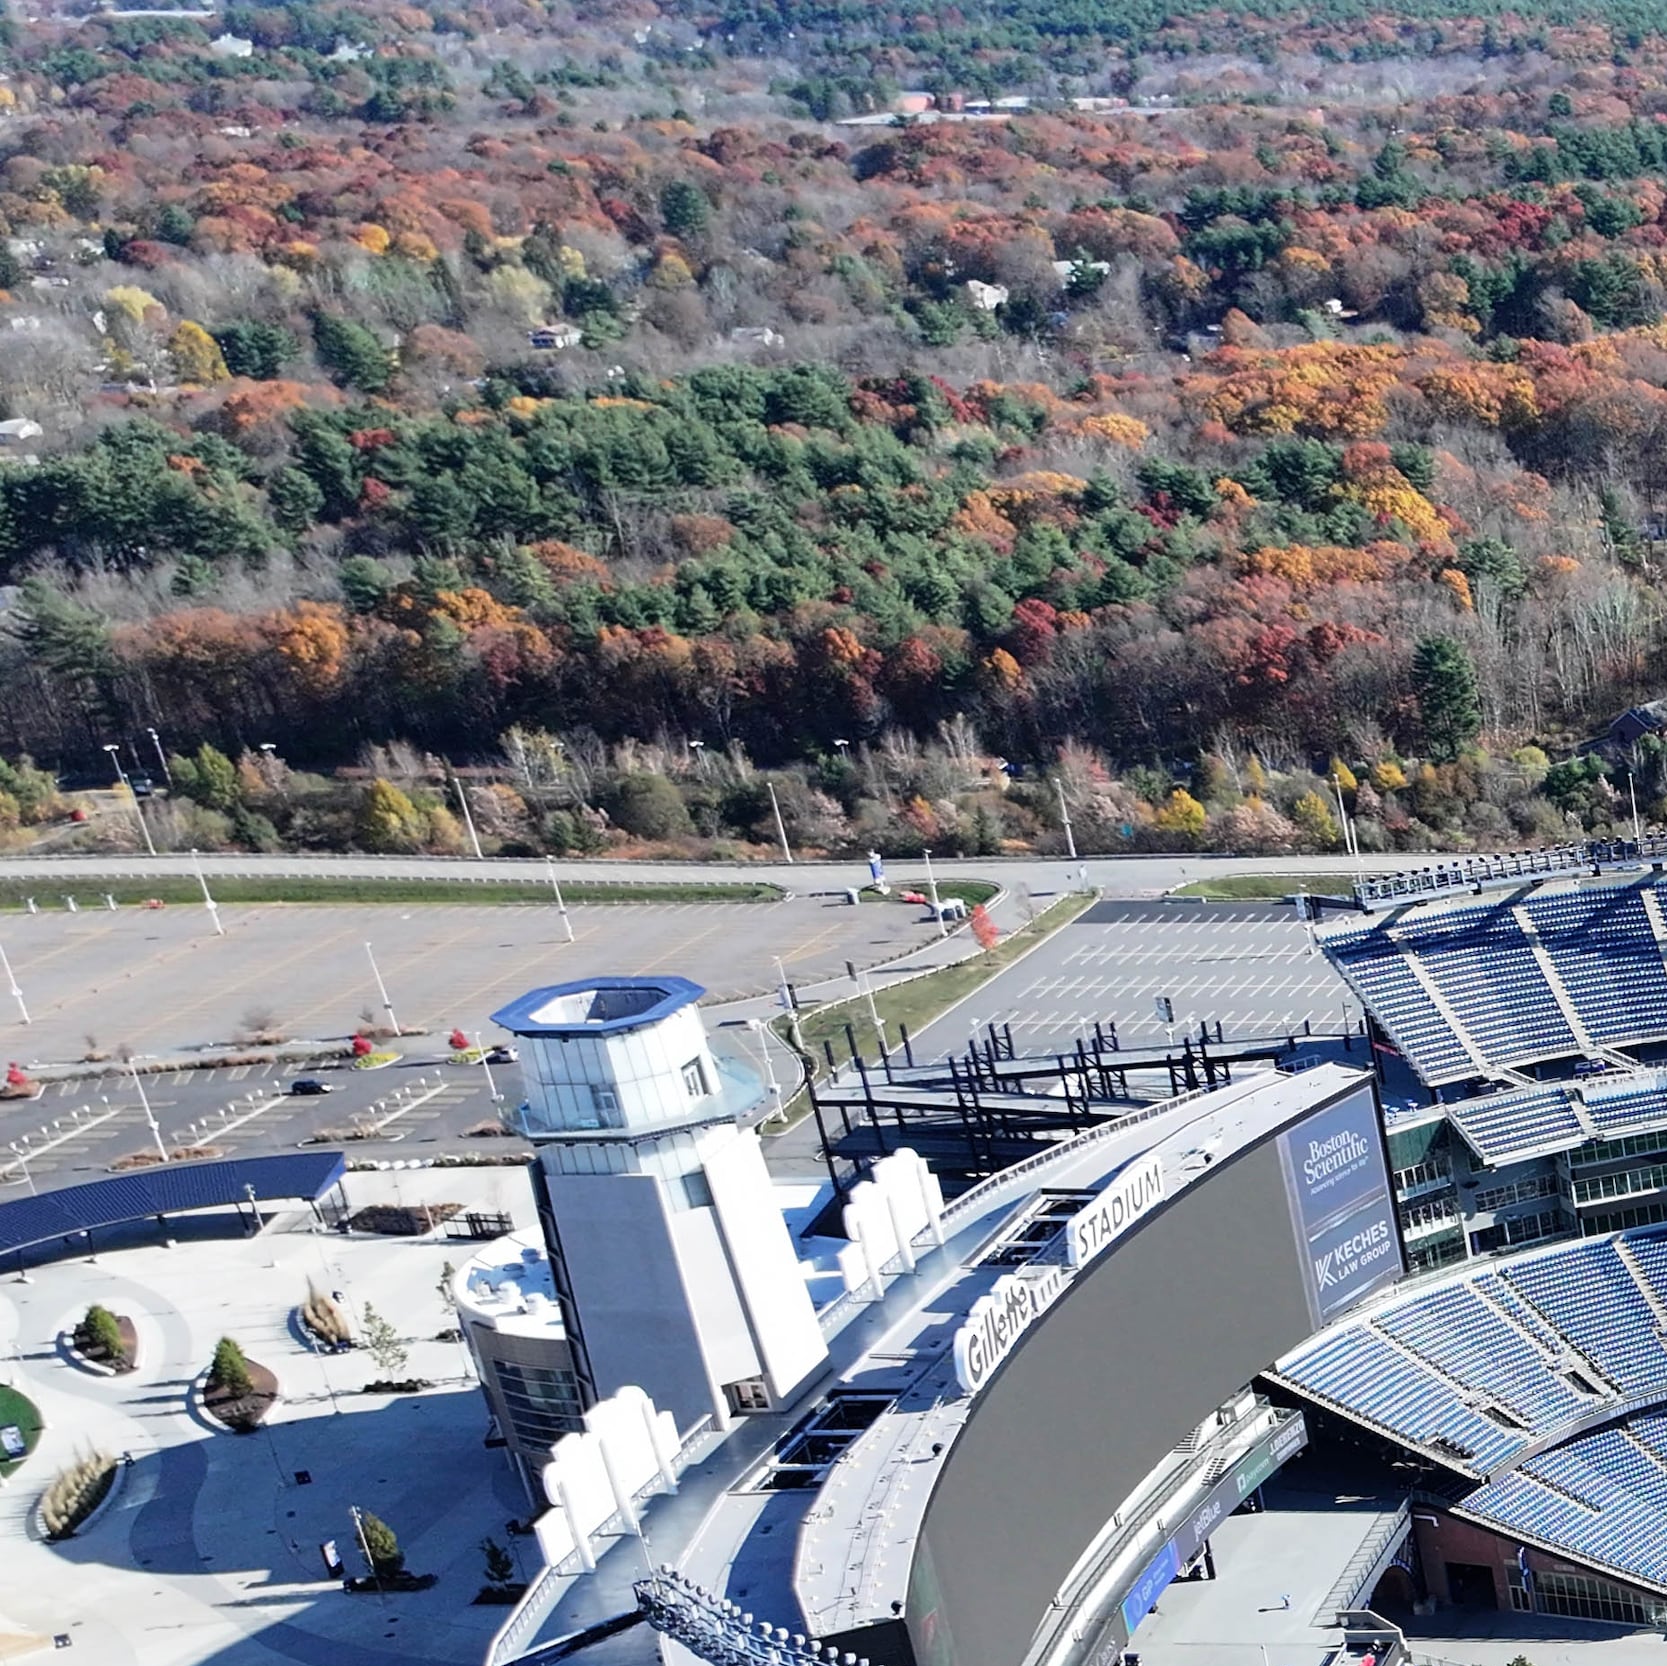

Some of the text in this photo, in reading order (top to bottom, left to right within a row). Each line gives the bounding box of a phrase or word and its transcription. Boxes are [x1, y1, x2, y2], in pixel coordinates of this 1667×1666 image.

[1303, 1132, 1369, 1185] Scientific
[1308, 1130, 1351, 1163] Boston
[1078, 1163, 1162, 1259] STADIUM
[1334, 1220, 1389, 1265] KECHES
[1337, 1241, 1391, 1280] LAW GROUP
[967, 1284, 1031, 1384] Gillette
[1192, 1501, 1222, 1543] jetBlue
